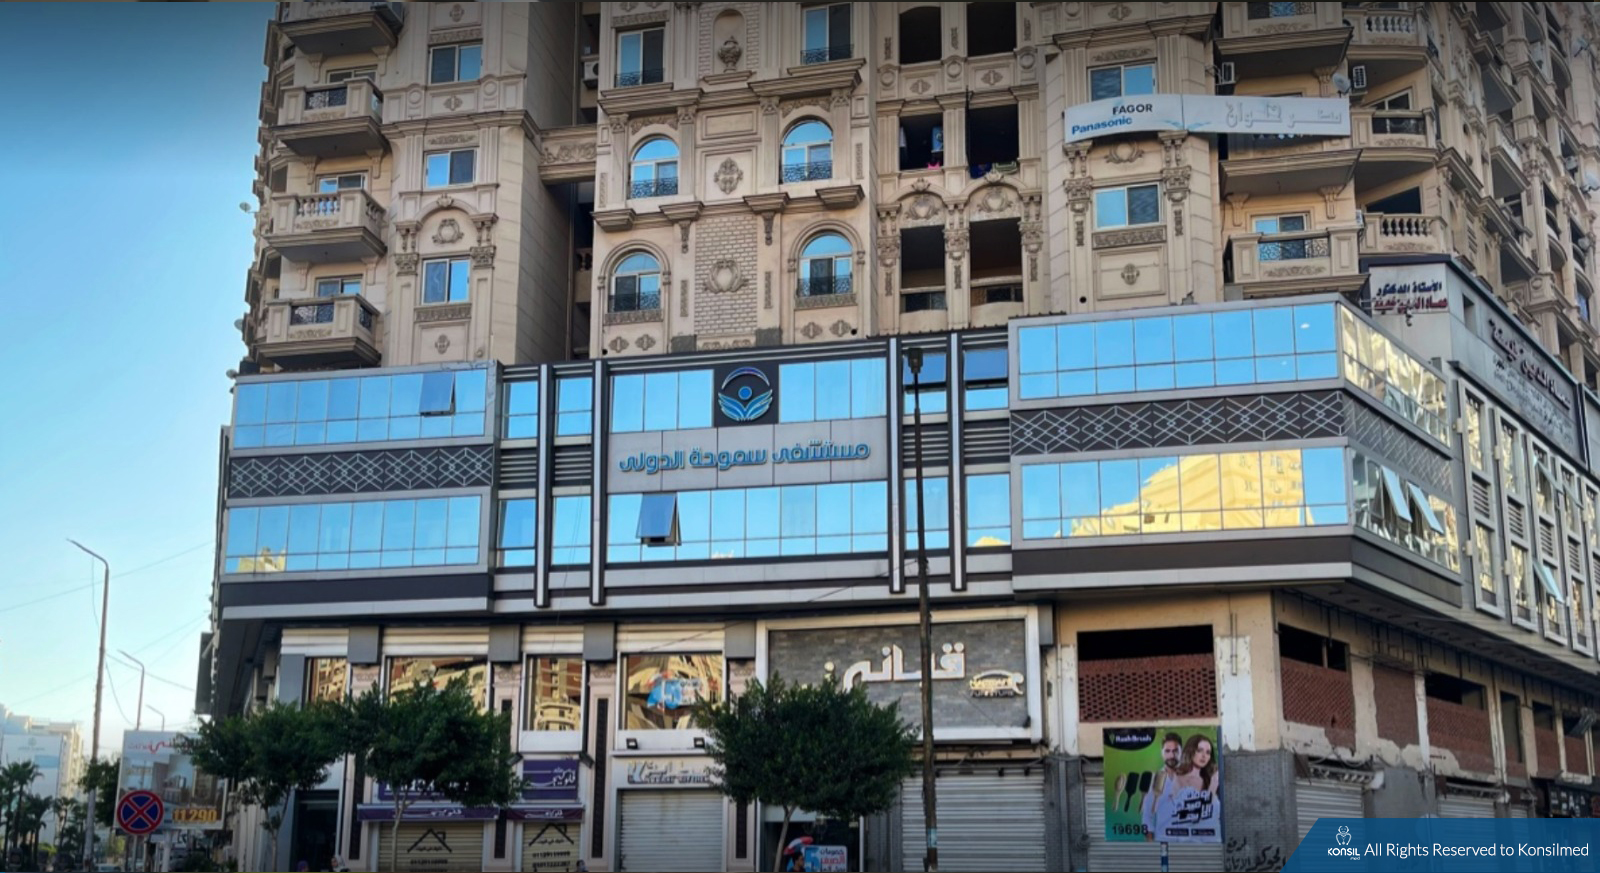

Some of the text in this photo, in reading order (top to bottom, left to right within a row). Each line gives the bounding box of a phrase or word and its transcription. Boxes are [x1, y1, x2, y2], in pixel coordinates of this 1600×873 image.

[1112, 103, 1153, 116] FAGOR
[1071, 115, 1132, 135] Panasonic
[689, 446, 767, 470] سموحة
[772, 439, 871, 463] مستشفى
[1112, 824, 1148, 835] 19698
